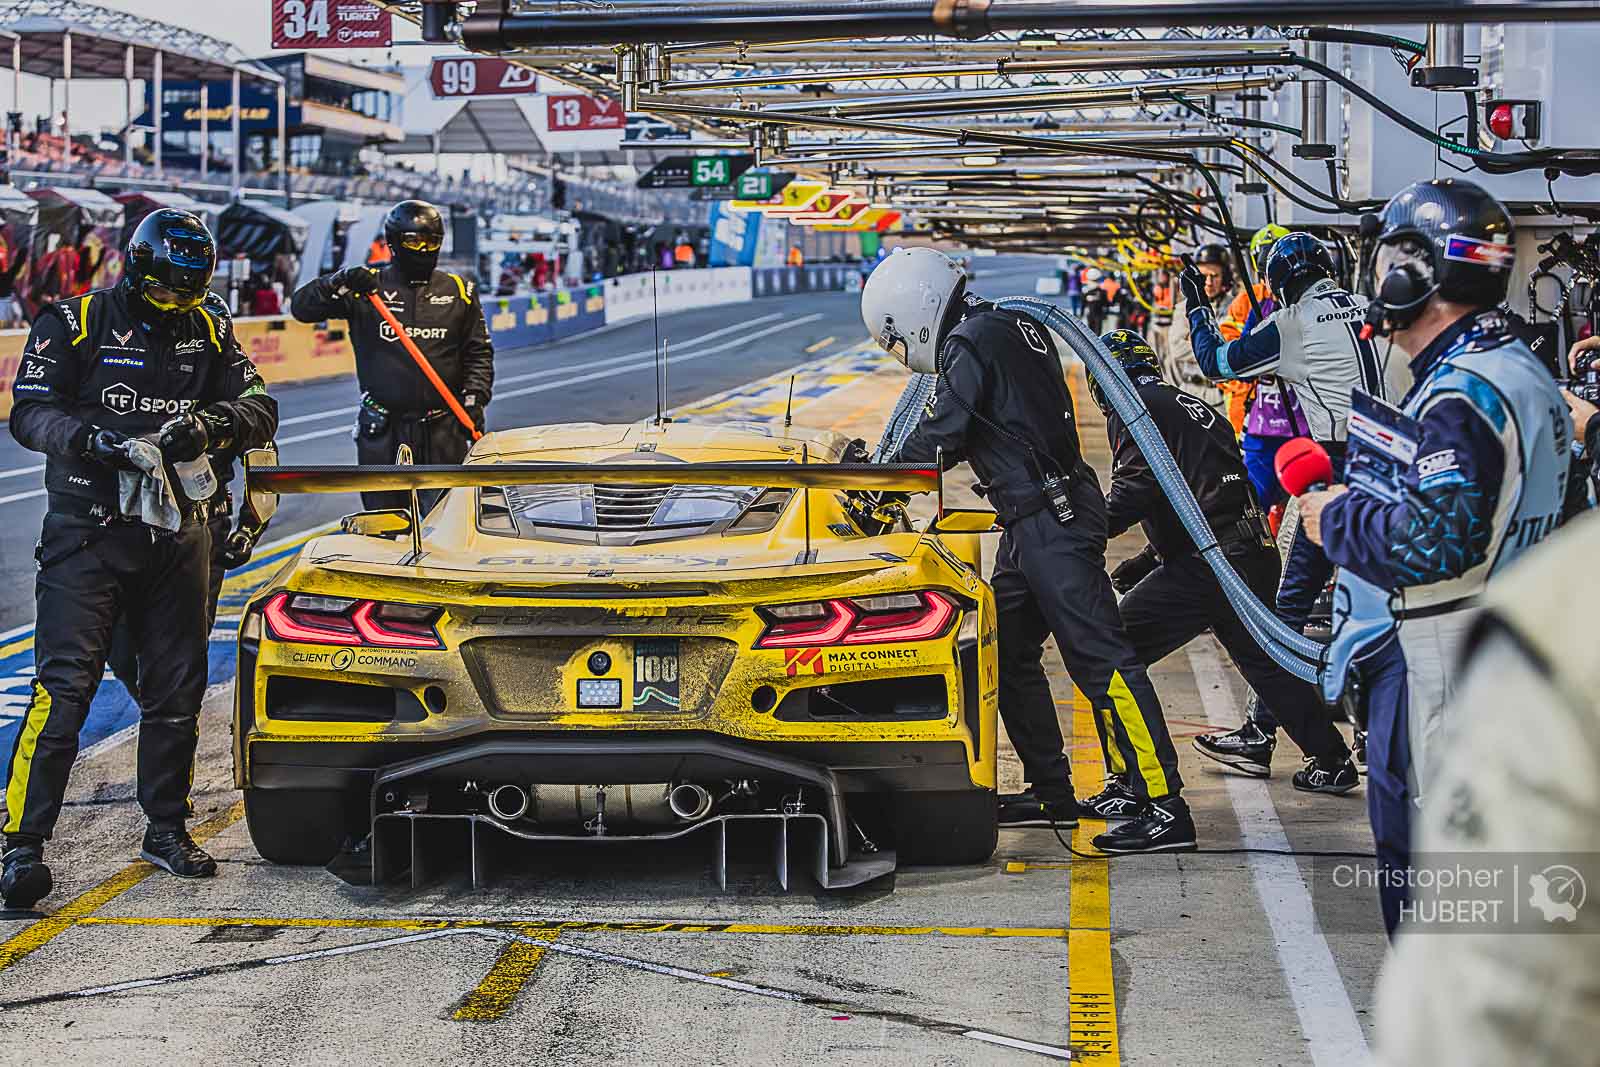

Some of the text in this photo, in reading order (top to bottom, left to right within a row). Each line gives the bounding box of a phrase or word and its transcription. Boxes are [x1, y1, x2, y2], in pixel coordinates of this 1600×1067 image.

[283, 0, 331, 39] 34
[339, 12, 380, 21] TURKEY
[442, 60, 477, 95] 99
[552, 99, 581, 127] 13
[696, 160, 725, 183] 54
[742, 176, 767, 195] 21
[60, 304, 80, 332] HRX
[1316, 305, 1370, 323] GOODYE
[403, 326, 449, 340] SPORT
[103, 358, 144, 367] GOODYEAR
[107, 393, 132, 409] TF
[68, 475, 92, 487] HRX
[1222, 473, 1241, 483] HRX
[293, 652, 417, 668] CLIENT COMMAND
[828, 648, 918, 663] MAX CONNECT
[829, 661, 880, 674] DIGITAL
